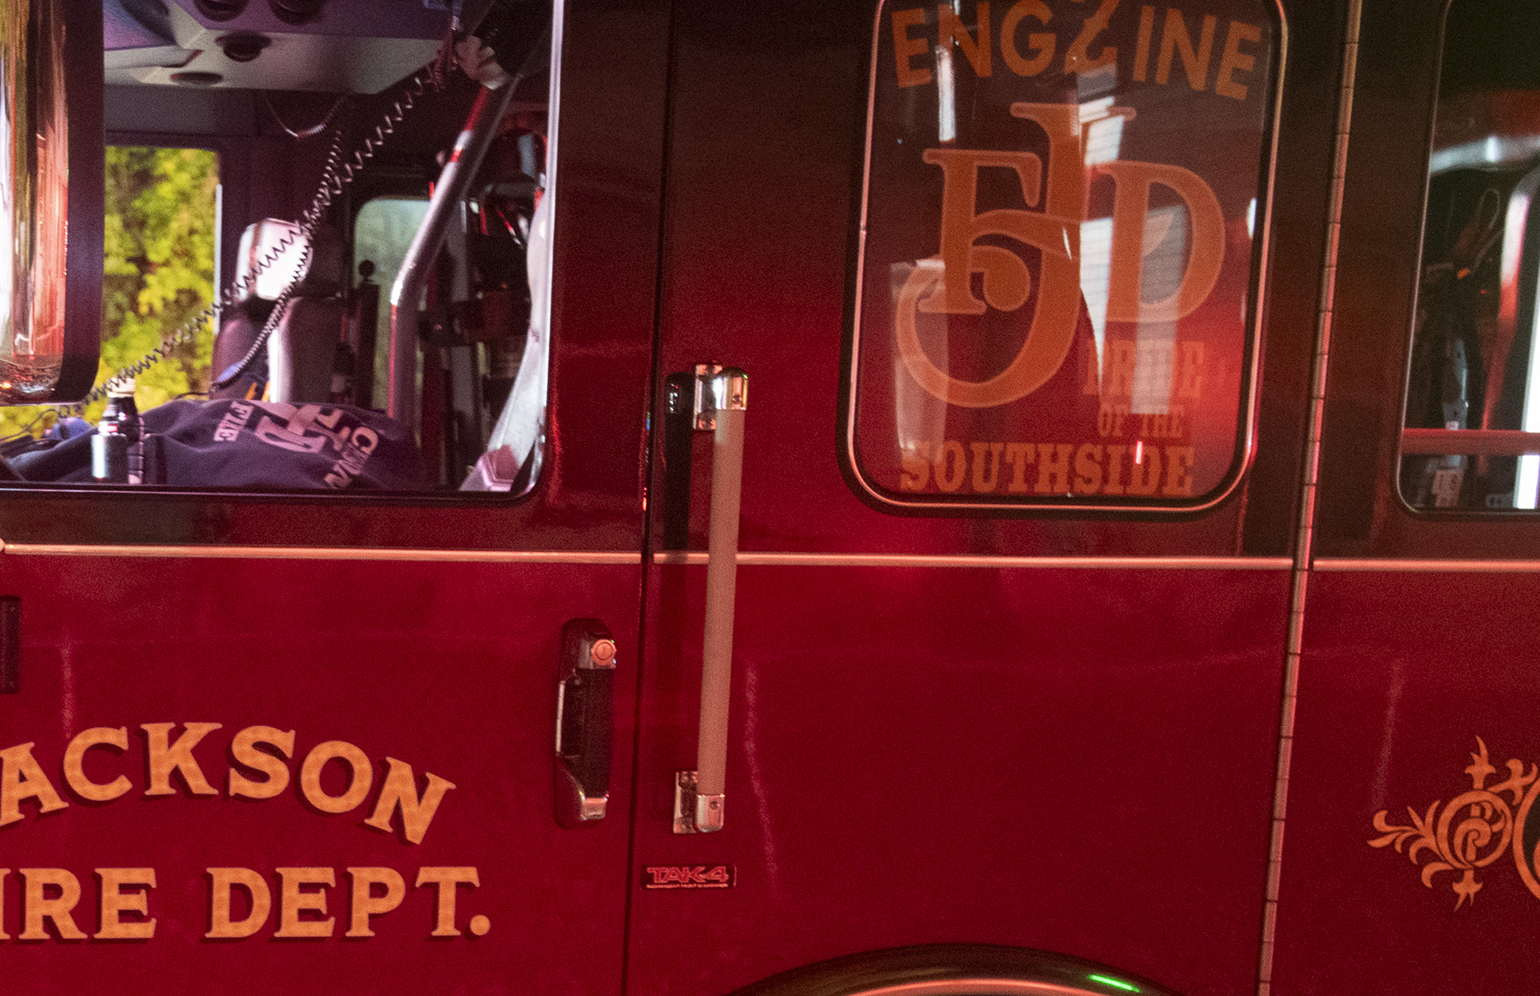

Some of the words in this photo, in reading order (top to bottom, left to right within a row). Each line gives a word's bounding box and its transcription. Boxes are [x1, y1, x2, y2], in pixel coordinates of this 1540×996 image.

[1097, 403, 1129, 438] OF
[1135, 403, 1185, 438] THE
[900, 440, 1196, 498] SOUTHSIDE
[647, 866, 729, 883] TAK-4
[203, 866, 492, 940] DEPT.
